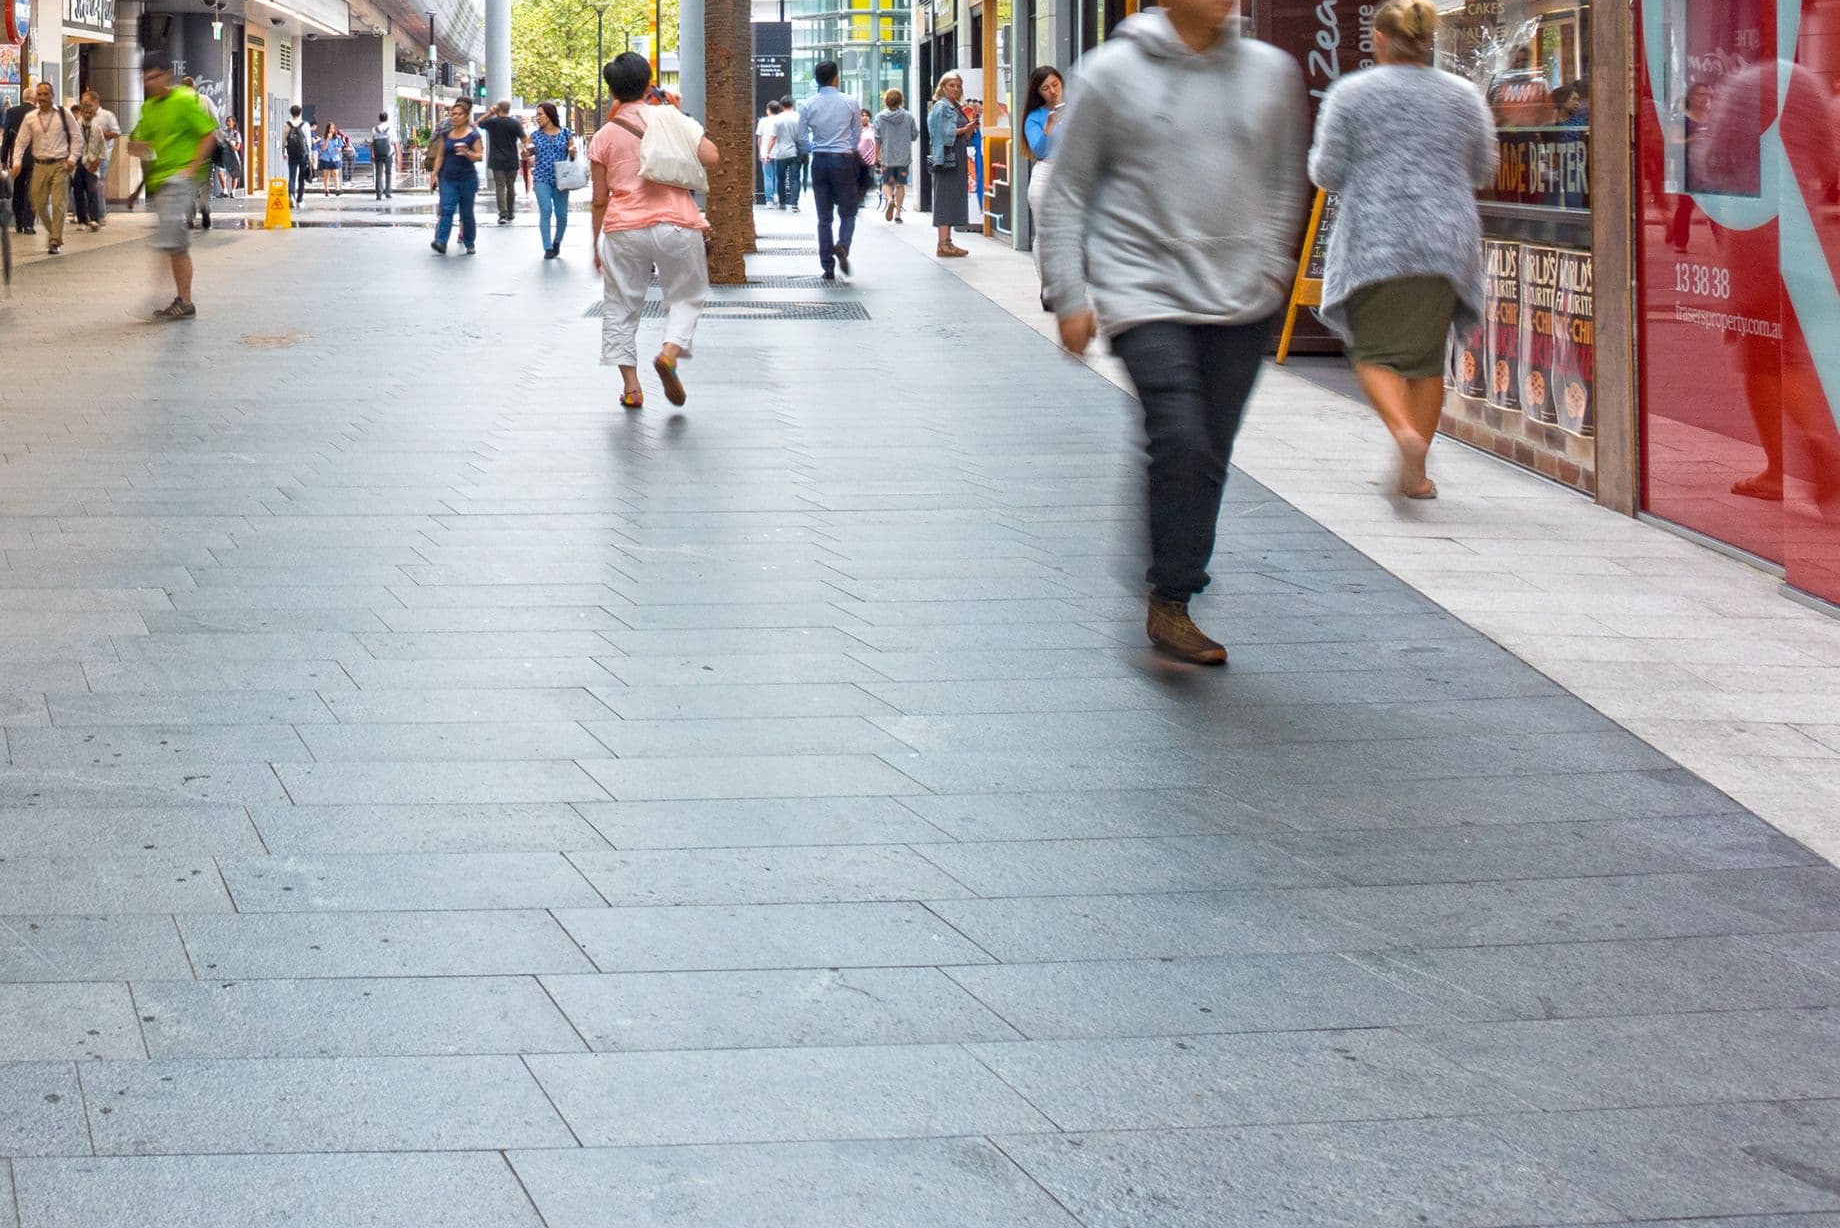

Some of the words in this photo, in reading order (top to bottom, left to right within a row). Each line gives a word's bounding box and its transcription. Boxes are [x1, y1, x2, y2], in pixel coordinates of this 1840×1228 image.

[1467, 2, 1505, 15] CAKES
[1360, 3, 1379, 53] pure
[171, 60, 187, 76] THE
[1497, 142, 1526, 192] ADE
[1529, 140, 1589, 194] BETTER
[1675, 262, 1690, 292] 13
[1692, 264, 1710, 295] 38
[1712, 267, 1730, 299] 38
